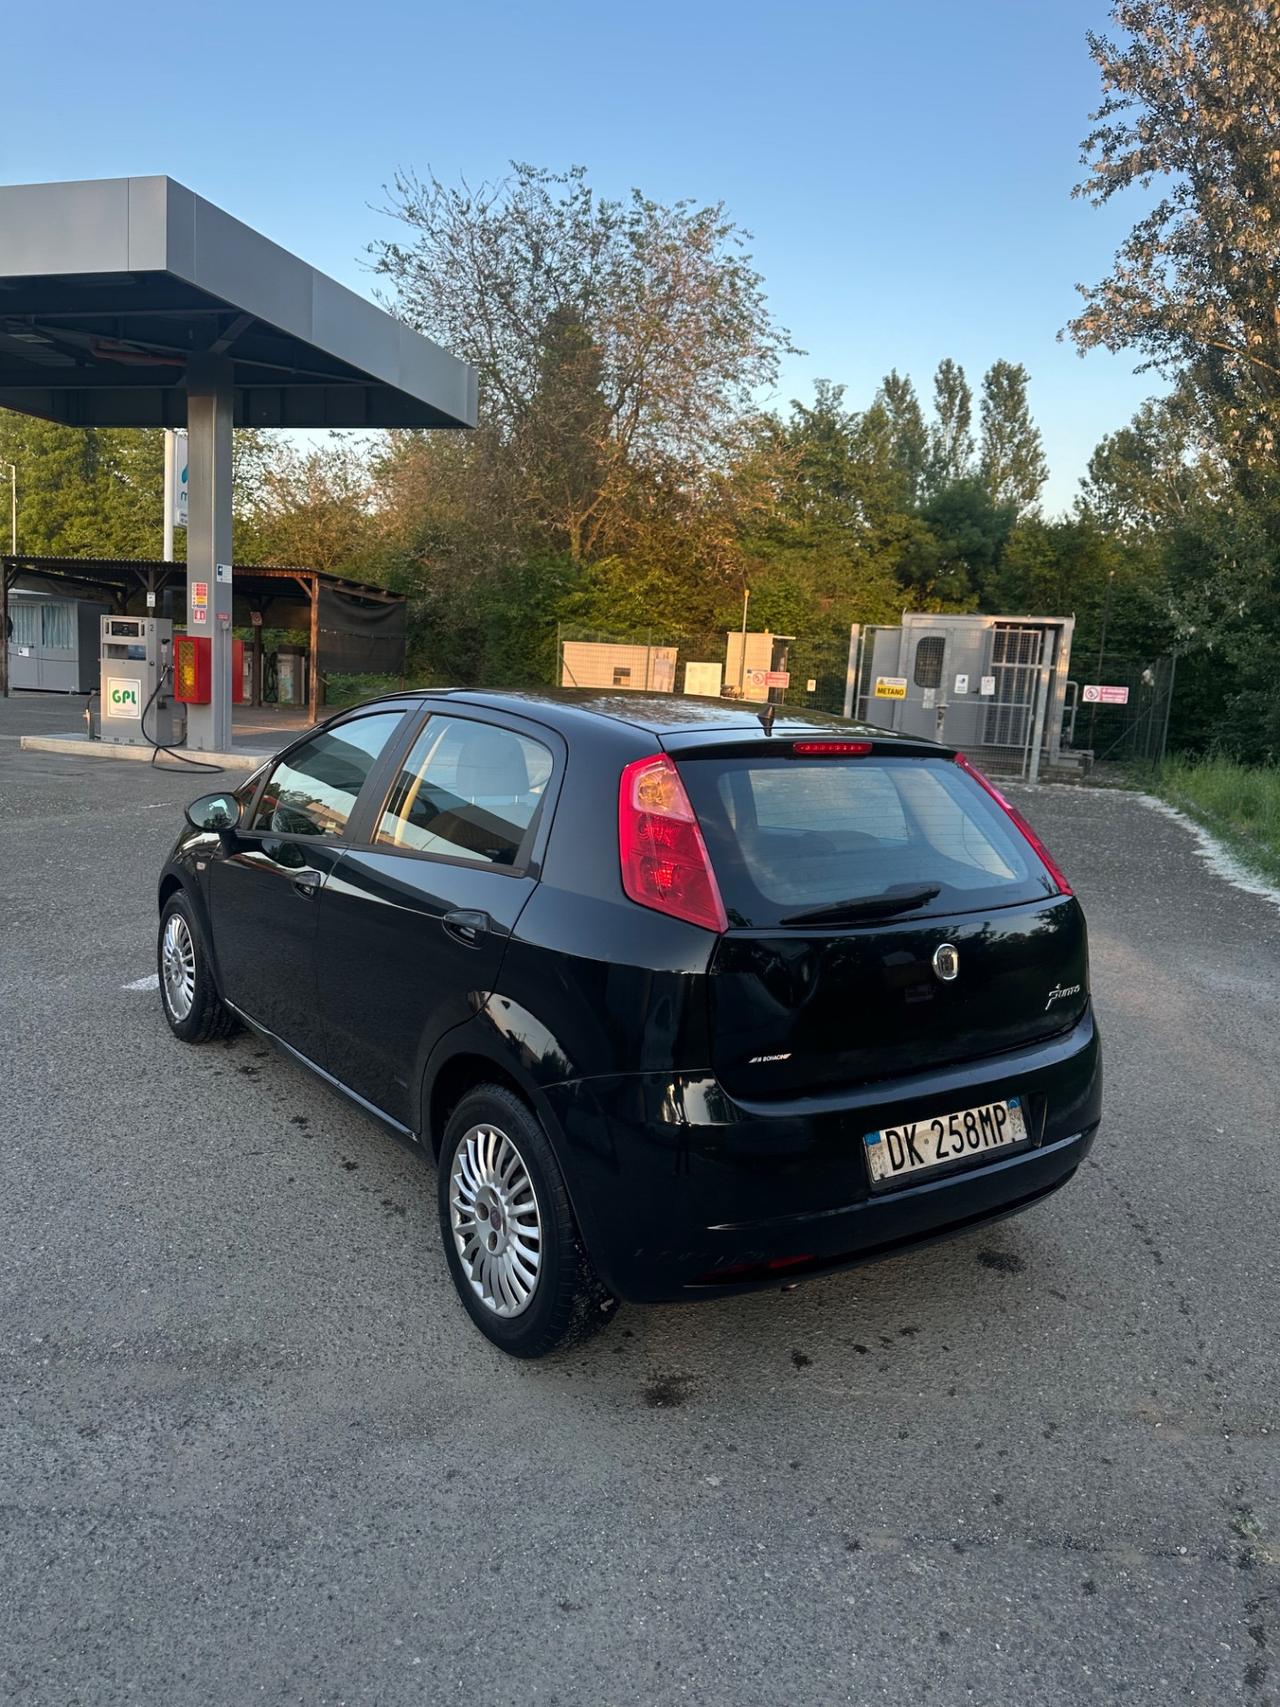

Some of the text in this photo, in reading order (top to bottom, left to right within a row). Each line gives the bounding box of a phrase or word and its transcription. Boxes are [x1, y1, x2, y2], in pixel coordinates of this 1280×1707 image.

[112, 689, 136, 704] GPL
[877, 687, 905, 696] METANO
[885, 1104, 1008, 1171] DK 258MP
